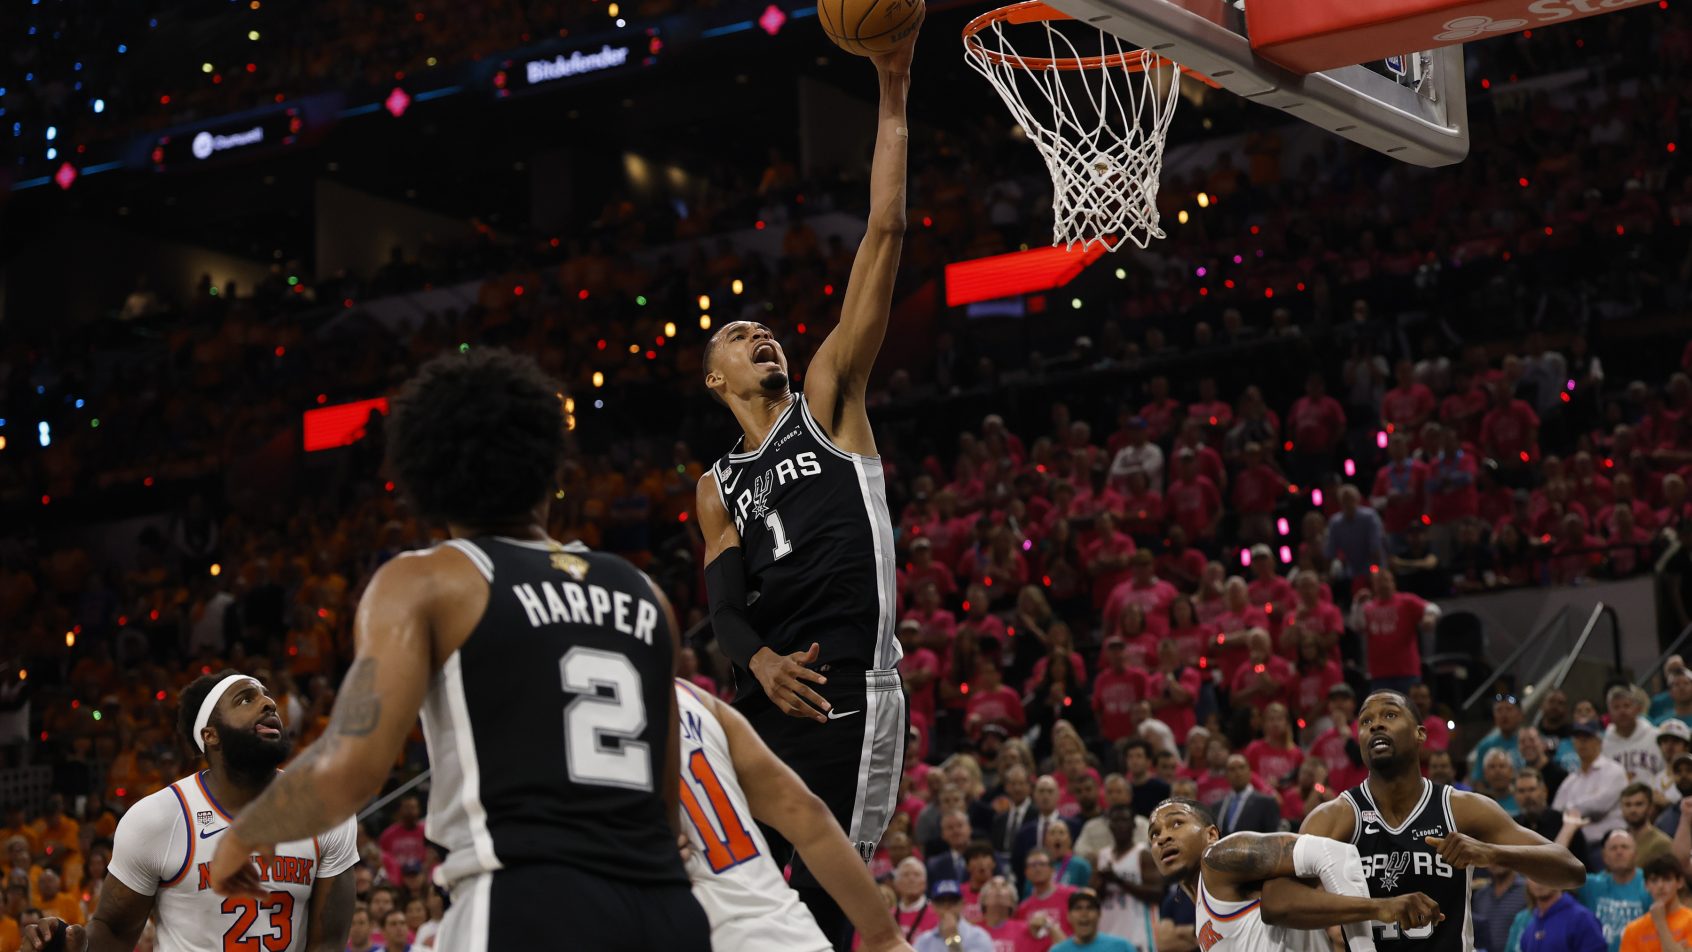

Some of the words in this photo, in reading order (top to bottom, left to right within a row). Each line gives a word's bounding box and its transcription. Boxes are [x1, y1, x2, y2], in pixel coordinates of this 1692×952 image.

[526, 43, 629, 84] Bitdefender
[776, 428, 799, 448] LEDGER
[764, 508, 793, 562] 1
[511, 580, 658, 646] HARPER
[558, 645, 655, 794] 2
[680, 747, 761, 875] 11
[1414, 827, 1440, 838] LEDGER
[255, 855, 314, 886] YORK
[1360, 851, 1454, 891] SPURS
[220, 890, 295, 952] 23
